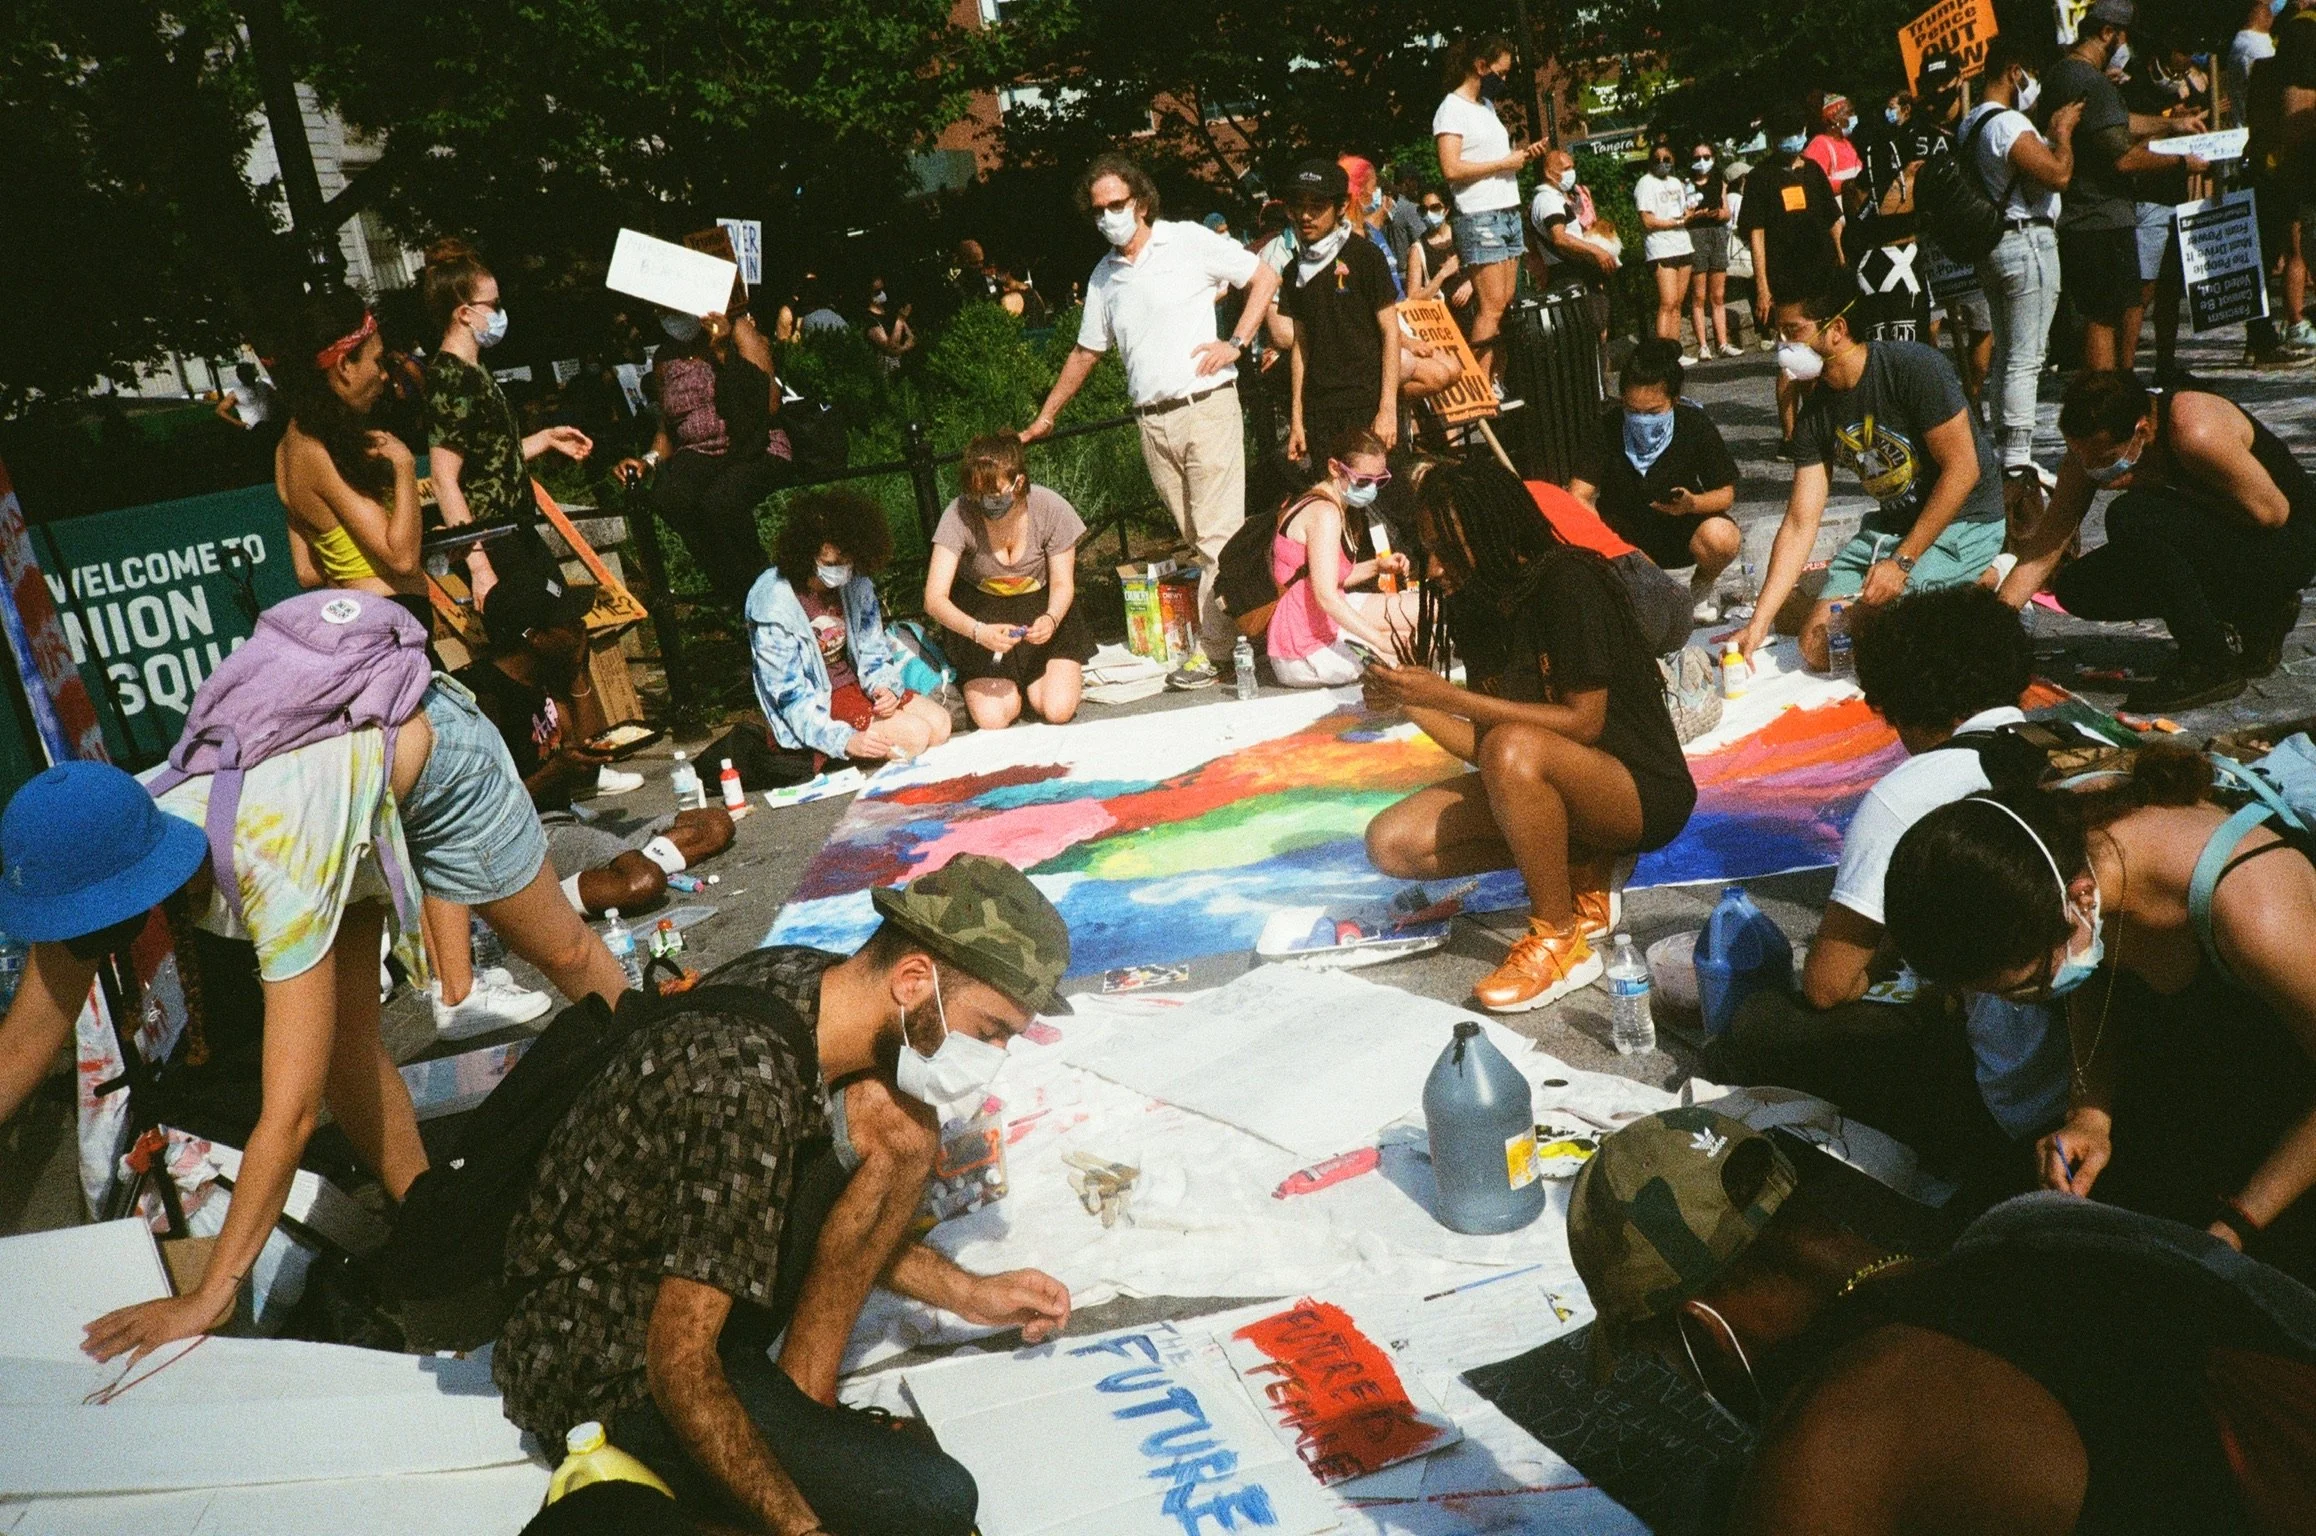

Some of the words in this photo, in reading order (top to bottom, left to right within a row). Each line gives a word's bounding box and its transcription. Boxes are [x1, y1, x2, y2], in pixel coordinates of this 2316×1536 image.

[1907, 0, 1974, 37] Trump
[1914, 6, 1977, 49] Pence
[1590, 140, 1635, 155] Panera
[2187, 230, 2223, 246] Power
[2225, 222, 2250, 236] From
[2186, 252, 2195, 262] It
[2198, 244, 2227, 258] Drive
[2193, 260, 2232, 275] People
[2224, 274, 2252, 289] Voted
[2200, 299, 2216, 311] Be
[2218, 288, 2254, 306] Cannot
[1403, 304, 1447, 326] rump/
[2207, 305, 2251, 323] Fascism
[44, 542, 221, 604] WELCOME
[222, 533, 267, 568] TO
[61, 585, 214, 665] NION
[107, 635, 246, 716] SQU
[1144, 1320, 1194, 1368] THE
[1244, 1361, 1365, 1486] FEMALE
[1065, 1334, 1280, 1536] FUTURE
